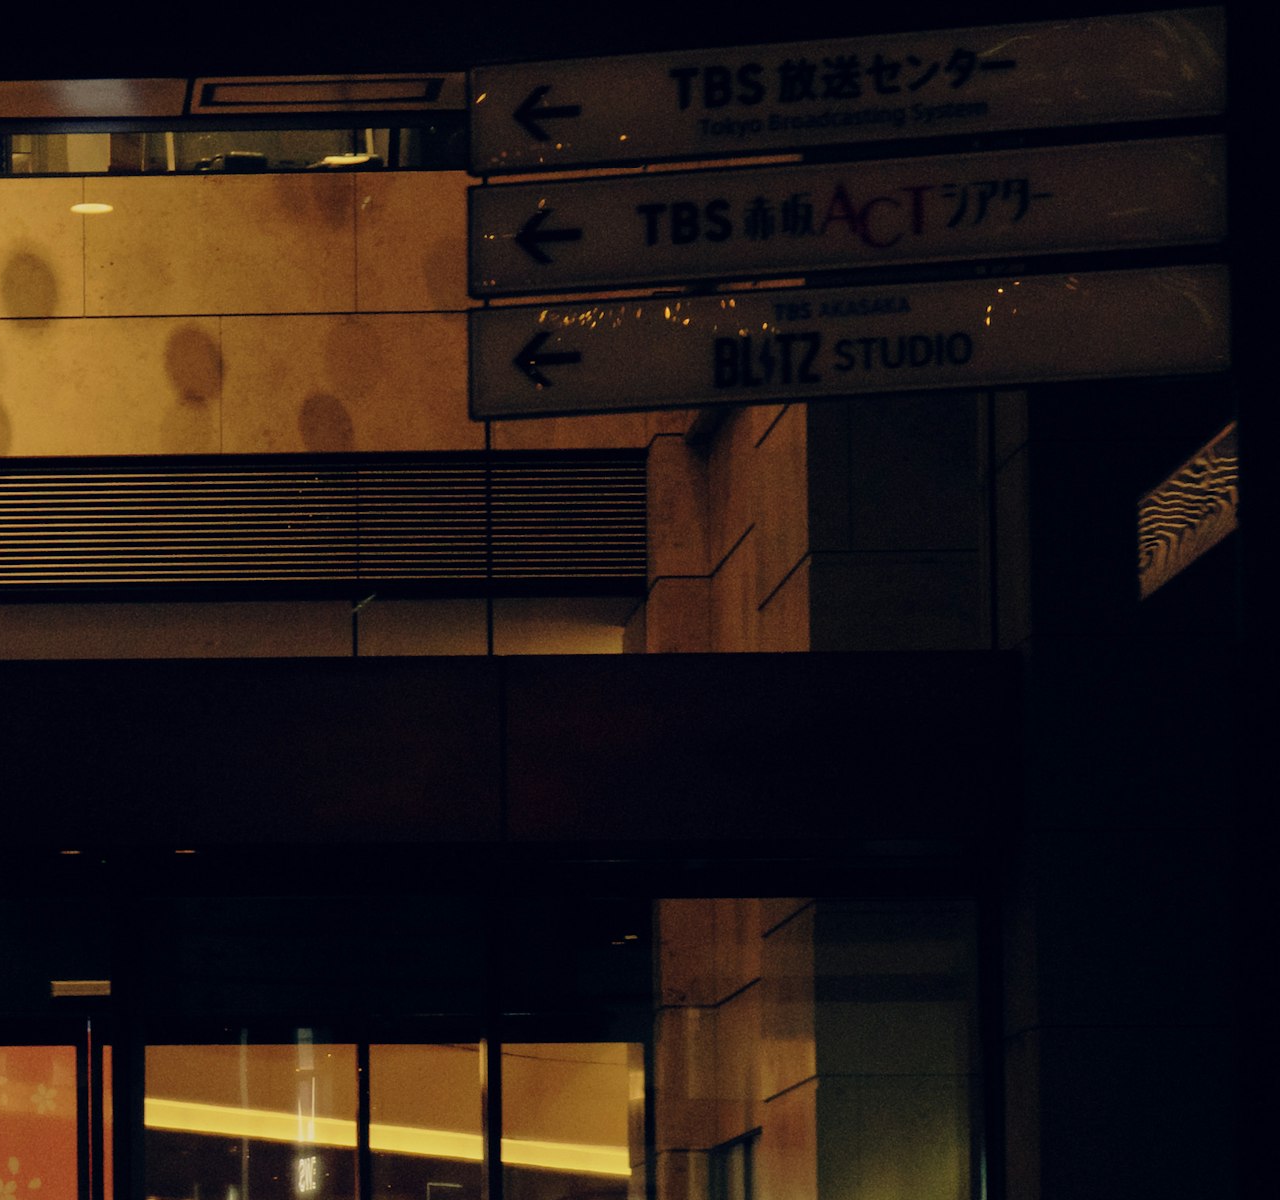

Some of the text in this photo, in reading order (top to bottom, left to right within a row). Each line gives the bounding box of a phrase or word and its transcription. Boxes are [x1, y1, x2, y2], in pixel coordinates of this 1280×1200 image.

[670, 48, 1016, 110] TBS 放送センター
[698, 101, 988, 137] Tokyo Broadcasting System
[637, 200, 732, 246] TBS
[773, 297, 912, 322] TBS AKASAKA
[713, 332, 973, 388] BLITZ STUDIO
